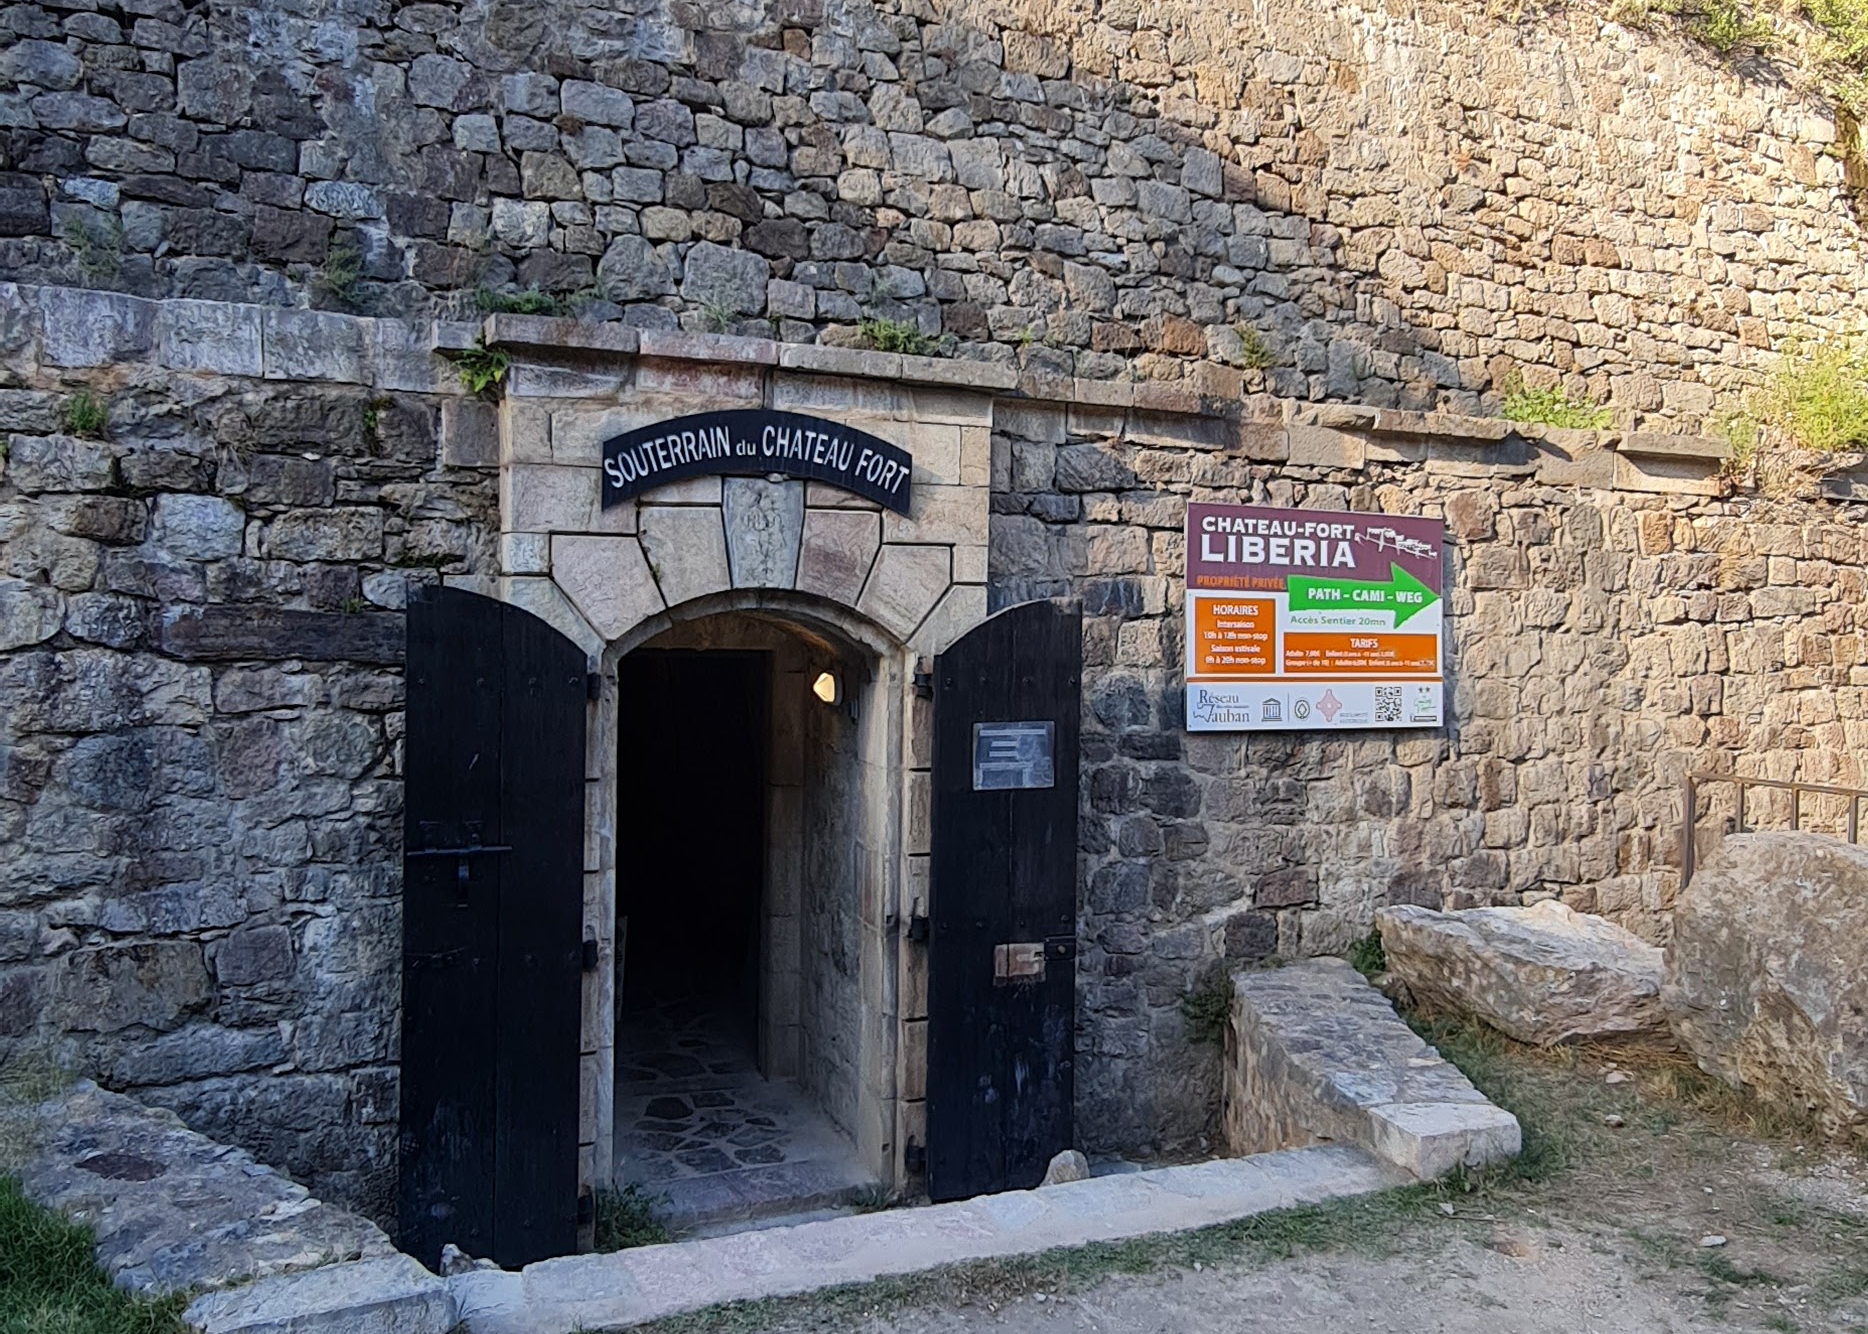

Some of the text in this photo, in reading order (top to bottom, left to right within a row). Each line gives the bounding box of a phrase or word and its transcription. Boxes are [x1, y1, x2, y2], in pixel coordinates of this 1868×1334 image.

[604, 425, 909, 494] SOUTERRAIN du CHATEAU FORT
[1202, 516, 1355, 539] CHATEAU-FORT
[1201, 534, 1356, 567] LIBERIA
[1308, 587, 1341, 601] PATH
[1352, 589, 1385, 602] CAMI
[1395, 590, 1423, 603] WEG
[1213, 604, 1259, 615] HORAIRES
[1290, 615, 1386, 626] Accès Sentier 20mn
[1350, 638, 1379, 648] TARIFS
[1199, 689, 1239, 704] Réseau
